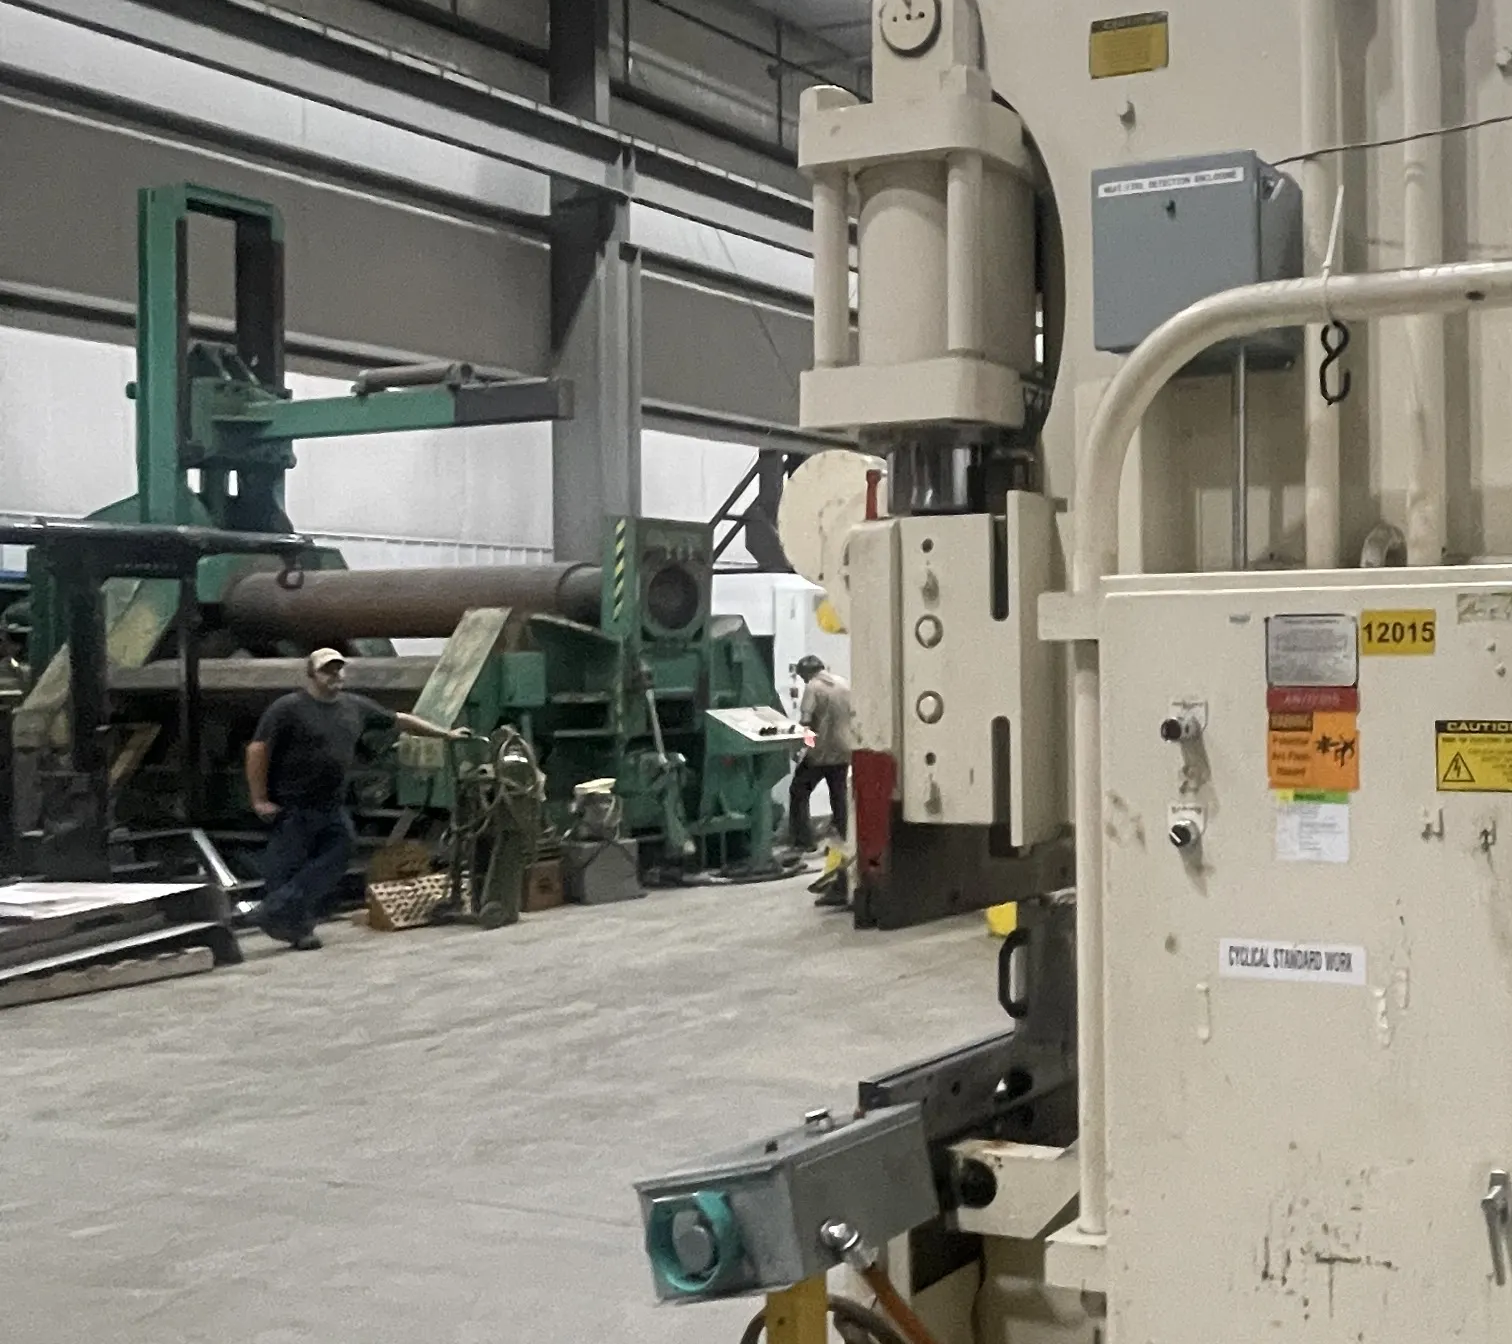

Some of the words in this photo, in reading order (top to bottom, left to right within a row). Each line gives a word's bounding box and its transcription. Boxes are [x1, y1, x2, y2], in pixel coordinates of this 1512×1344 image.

[1362, 622, 1435, 644] 12015
[1273, 948, 1322, 971] STANDARD
[1325, 951, 1353, 973] WORK
